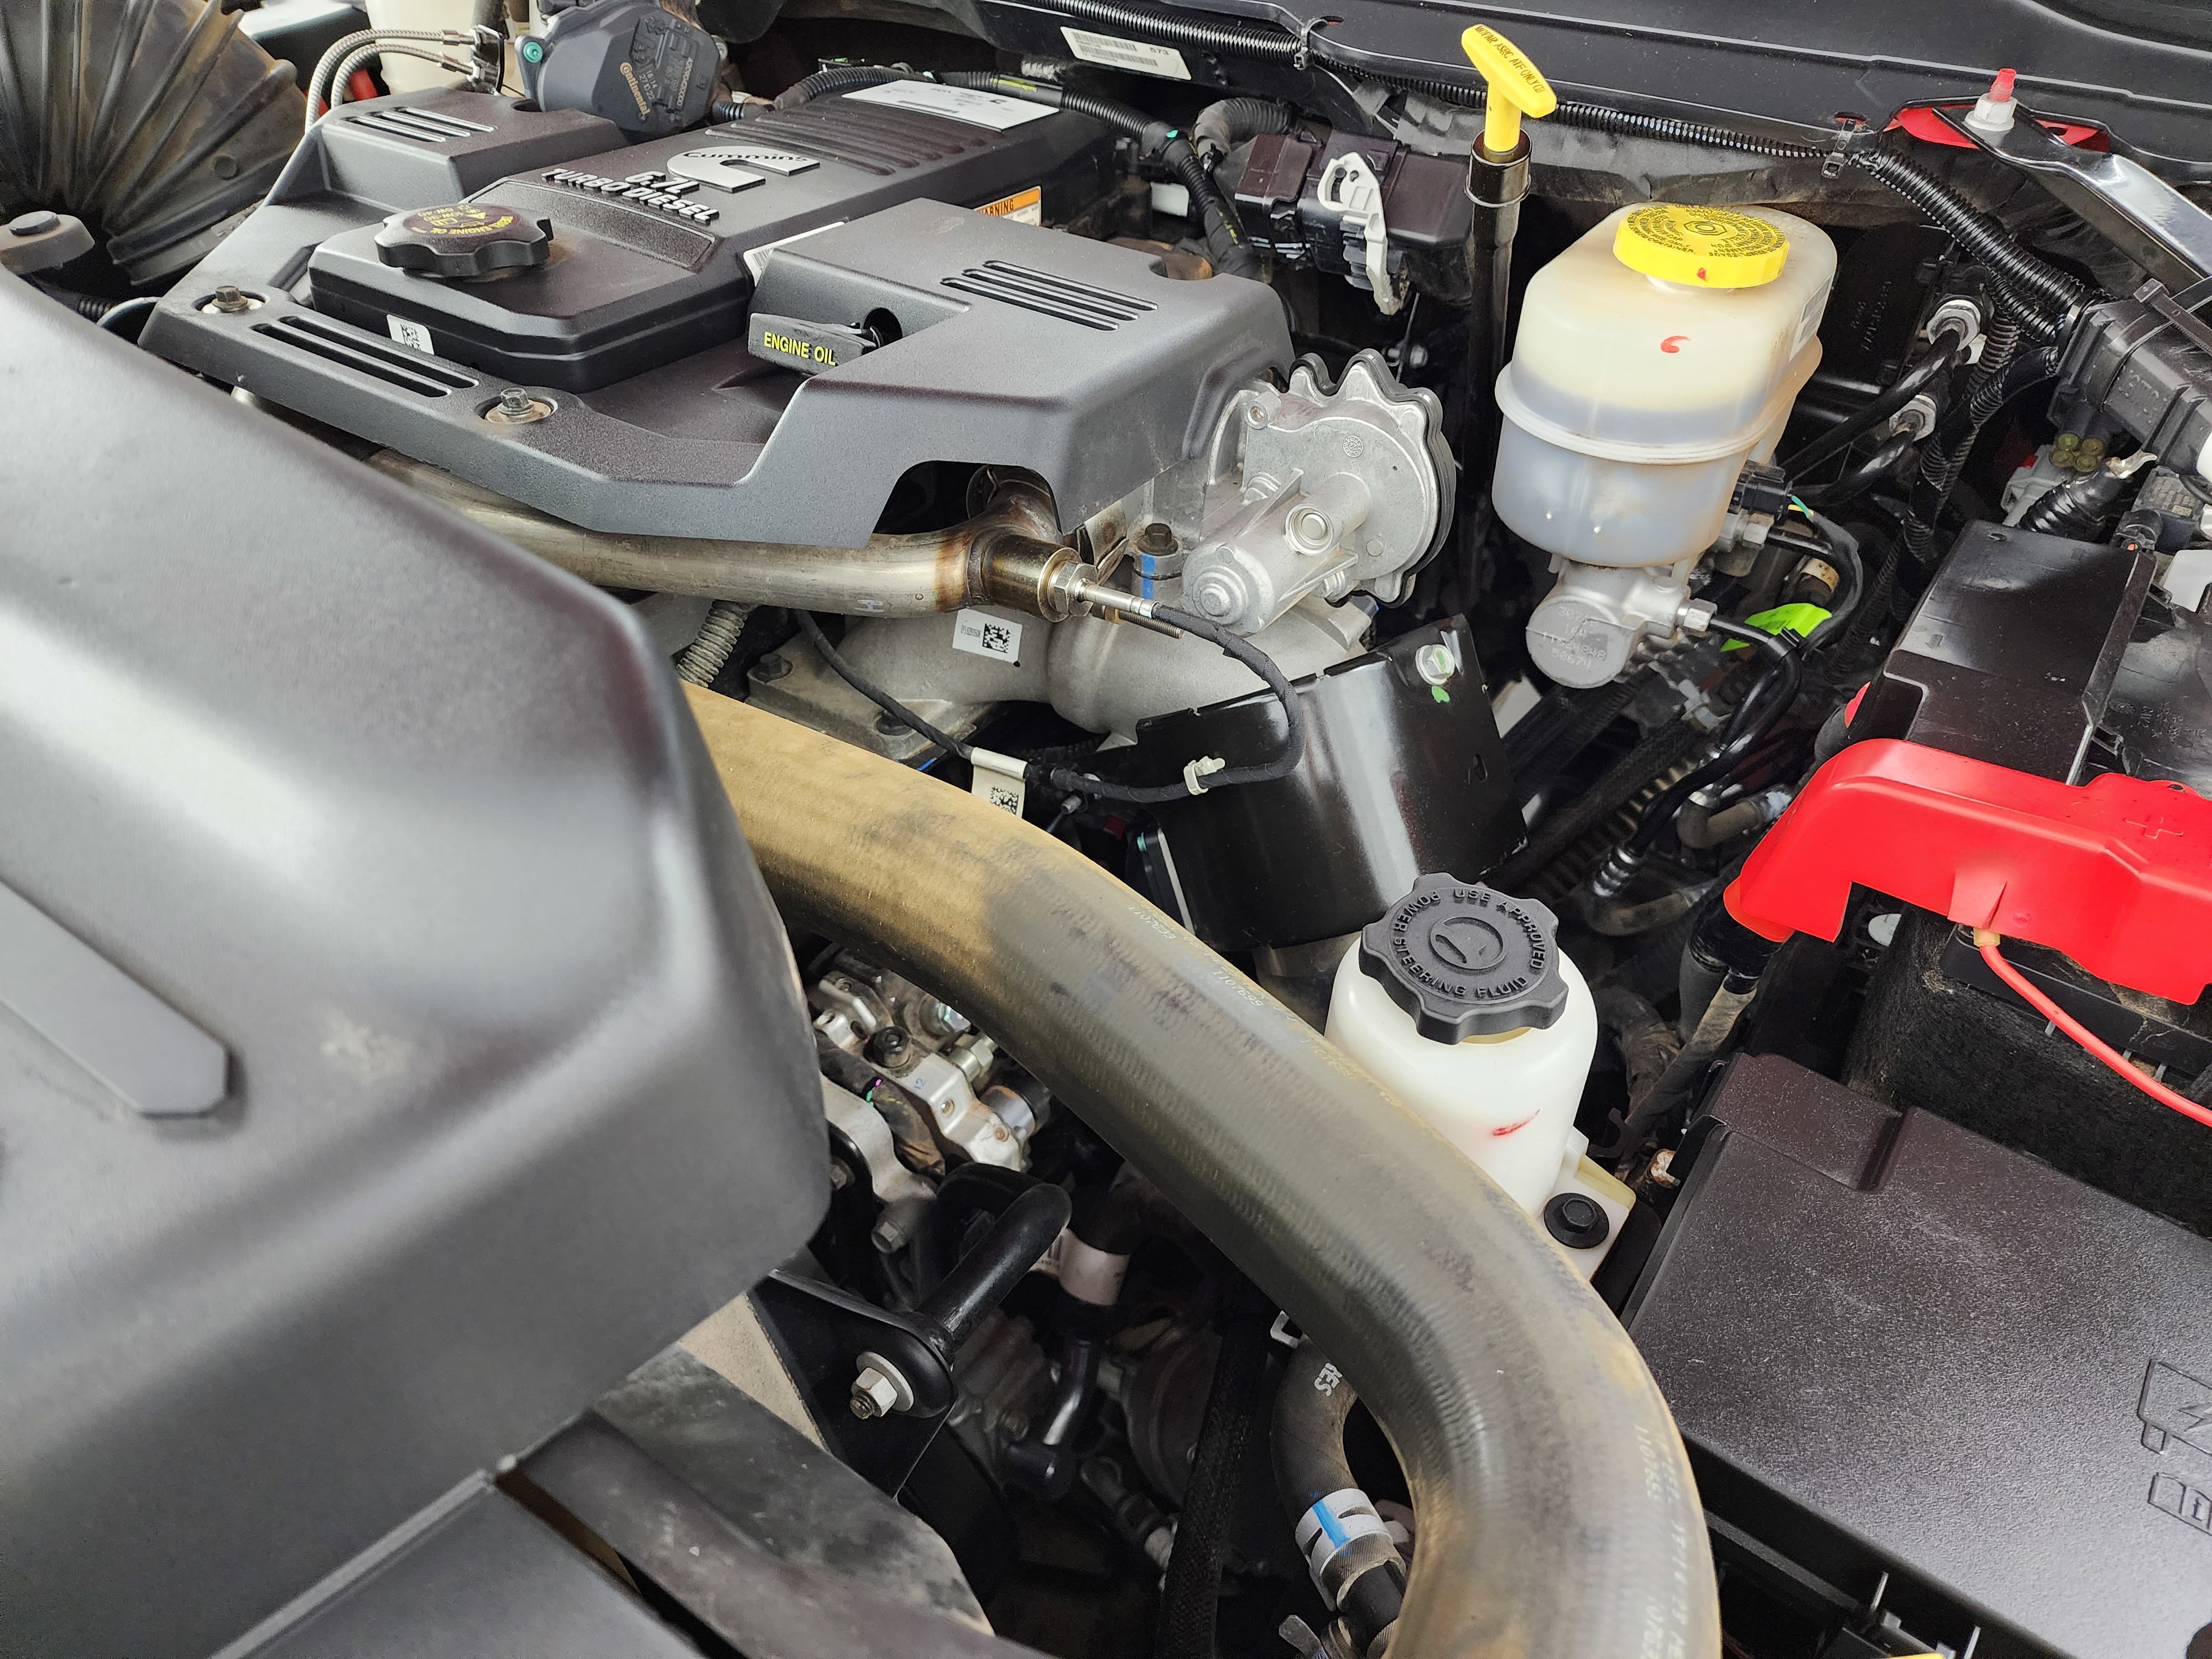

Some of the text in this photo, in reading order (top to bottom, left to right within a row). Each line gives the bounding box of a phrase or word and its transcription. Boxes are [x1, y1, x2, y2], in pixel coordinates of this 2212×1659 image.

[1509, 58, 1526, 70] ATF
[1520, 69, 1540, 86] ONLY
[682, 151, 810, 163] Cummins
[541, 168, 719, 224] TURBO DIESEL
[979, 199, 1014, 217] ARNING
[764, 331, 837, 367] ENGINE OIL
[1393, 890, 1529, 997] POWER STEERING FLUID
[1453, 888, 1547, 970] USE APPROVED
[1212, 970, 1264, 1006] 1107699
